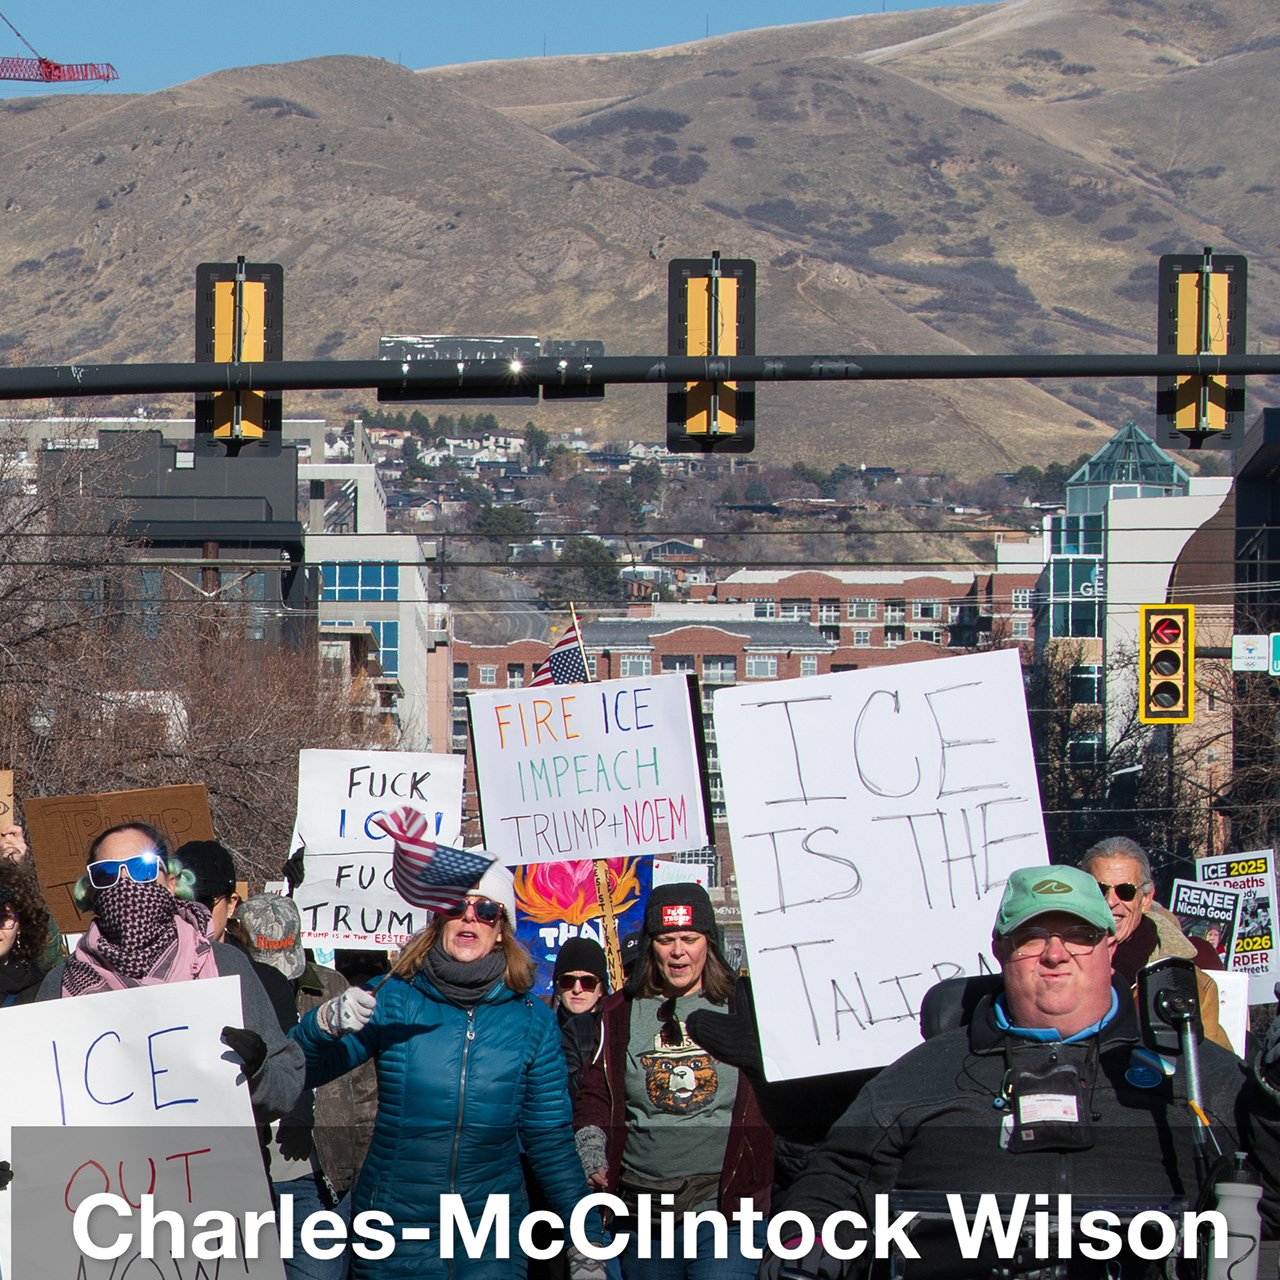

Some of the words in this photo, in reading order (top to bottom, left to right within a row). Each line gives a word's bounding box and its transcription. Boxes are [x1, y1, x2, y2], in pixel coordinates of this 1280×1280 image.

[495, 696, 580, 749] FIRE
[601, 688, 654, 734] ICE
[741, 681, 1011, 806] ICE
[348, 765, 431, 802] FUCK
[518, 747, 659, 802] IMPEACH
[742, 826, 863, 915] IS
[871, 796, 1040, 910] THE
[1204, 864, 1227, 879] ICE
[1230, 859, 1266, 876] 2025
[336, 864, 395, 890] FUC
[1177, 901, 1205, 917] Nicole
[1207, 906, 1233, 921] Good
[1179, 887, 1235, 909] RENEE
[302, 902, 413, 934] TRUM
[257, 933, 294, 950] Elwood
[301, 931, 329, 940] TRUMP
[1236, 935, 1271, 952] 2026
[52, 1025, 199, 1125] ICE
[65, 1148, 211, 1214] OUT
